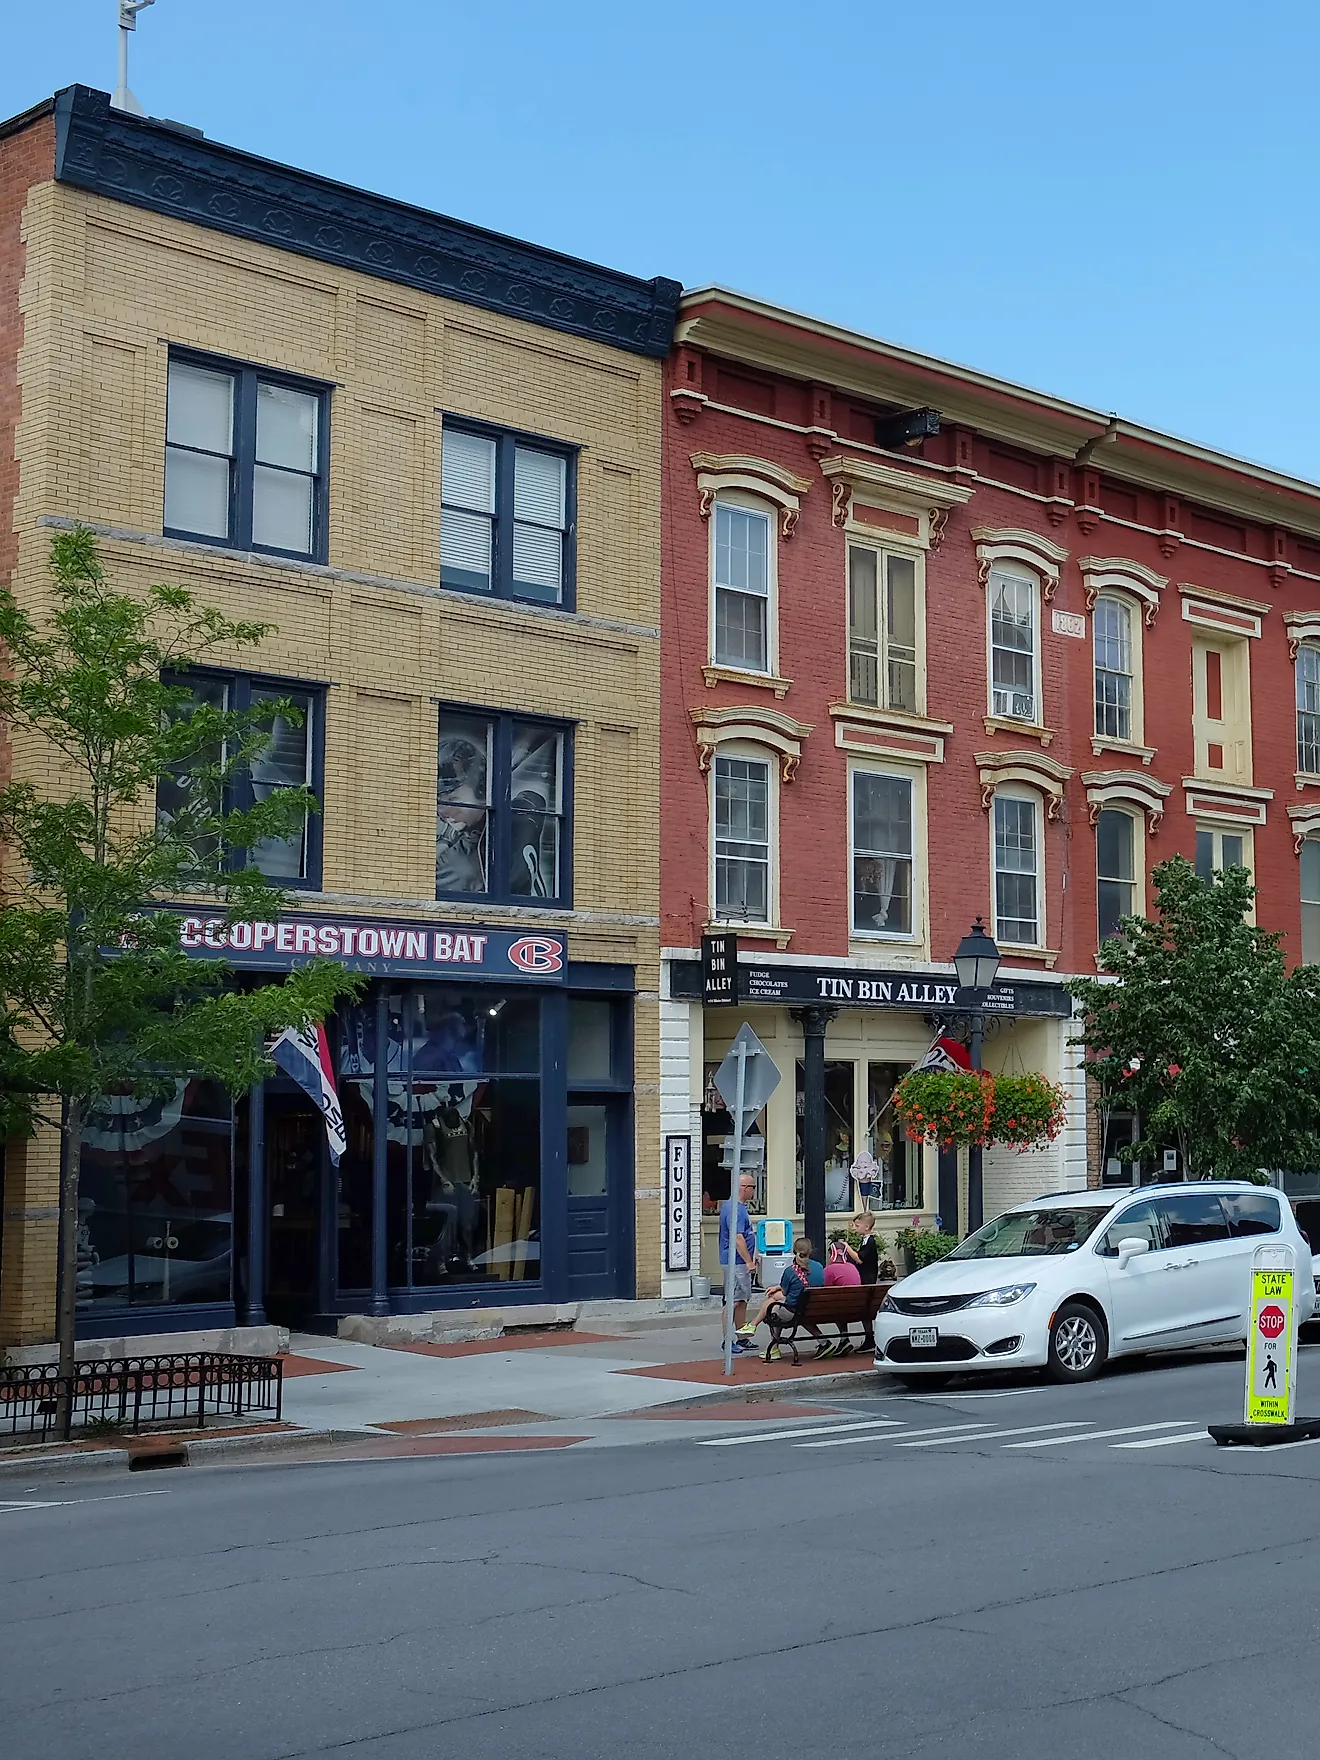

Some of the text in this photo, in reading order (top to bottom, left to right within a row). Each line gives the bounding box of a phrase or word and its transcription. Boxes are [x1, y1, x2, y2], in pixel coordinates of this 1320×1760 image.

[179, 916, 488, 963] COOPERSTOWN BAT
[711, 940, 726, 954] TIN
[290, 958, 391, 973] CPANY
[711, 957, 726, 971] BIN
[749, 971, 771, 979] FUDGE
[705, 977, 732, 992] ALLEY
[749, 979, 789, 988] CHOCOLATES
[749, 987, 782, 996] ICE CREAM
[816, 977, 958, 1004] TIN BIN ALLEY
[999, 987, 1015, 995] GIFTS
[981, 1001, 1015, 1009] OLLECTIBLES
[673, 1146, 683, 1243] FUDGE
[1261, 1274, 1287, 1284] STATE
[1264, 1286, 1283, 1296] LAW
[1260, 1316, 1284, 1329] STOP
[1264, 1342, 1277, 1350] FOR
[1260, 1400, 1279, 1408] WITHIN
[1252, 1409, 1285, 1418] CROSSWALK
